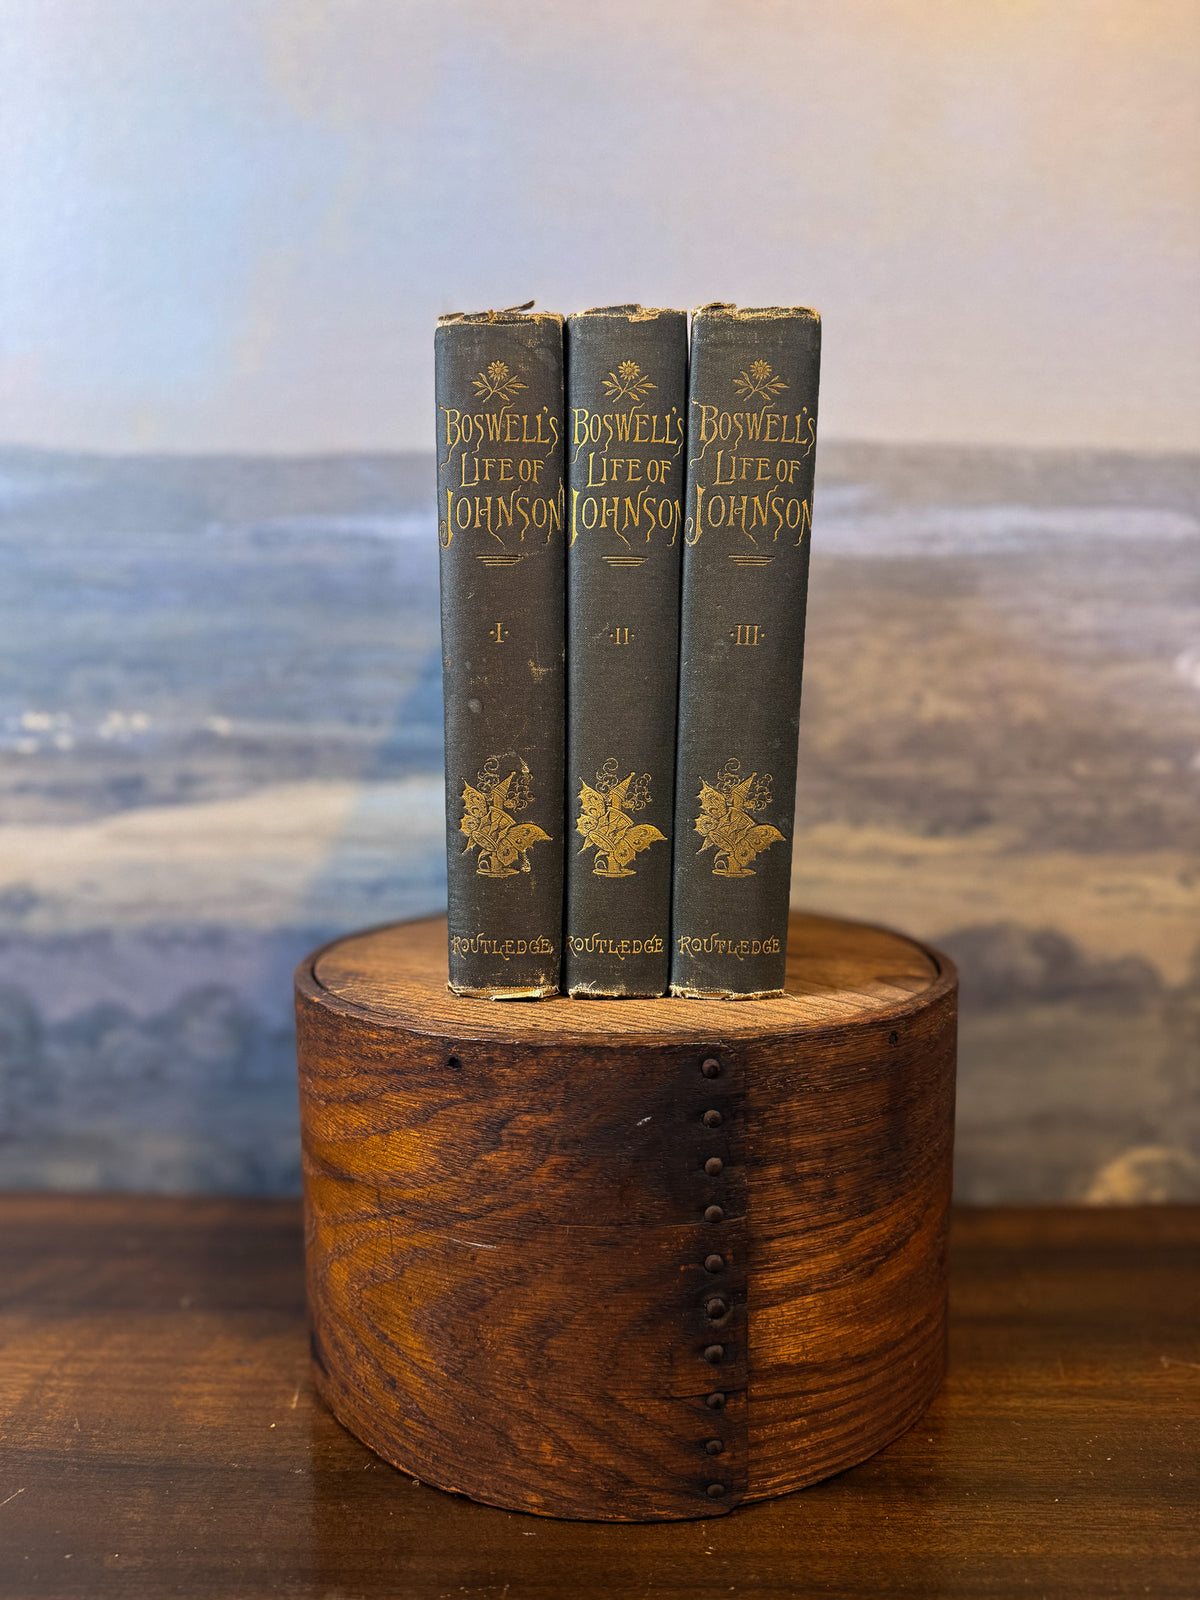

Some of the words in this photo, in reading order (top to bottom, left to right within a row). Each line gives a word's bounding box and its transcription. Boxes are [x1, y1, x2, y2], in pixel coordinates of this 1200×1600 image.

[440, 403, 558, 471] BOSWELL'S
[569, 403, 685, 464] BOSWELL'S
[690, 401, 815, 467] BOSWELL'S
[459, 452, 515, 487] LIFE
[519, 459, 545, 485] OF
[585, 452, 642, 487] LIFE
[646, 459, 672, 485] OF
[712, 450, 772, 485] LIFE
[776, 458, 801, 485] OF
[440, 477, 565, 550] JOHNSON
[685, 481, 814, 549] JOHNSON
[452, 933, 552, 960] ROUTLEDGE
[678, 933, 781, 960] ROUTLEDGE
